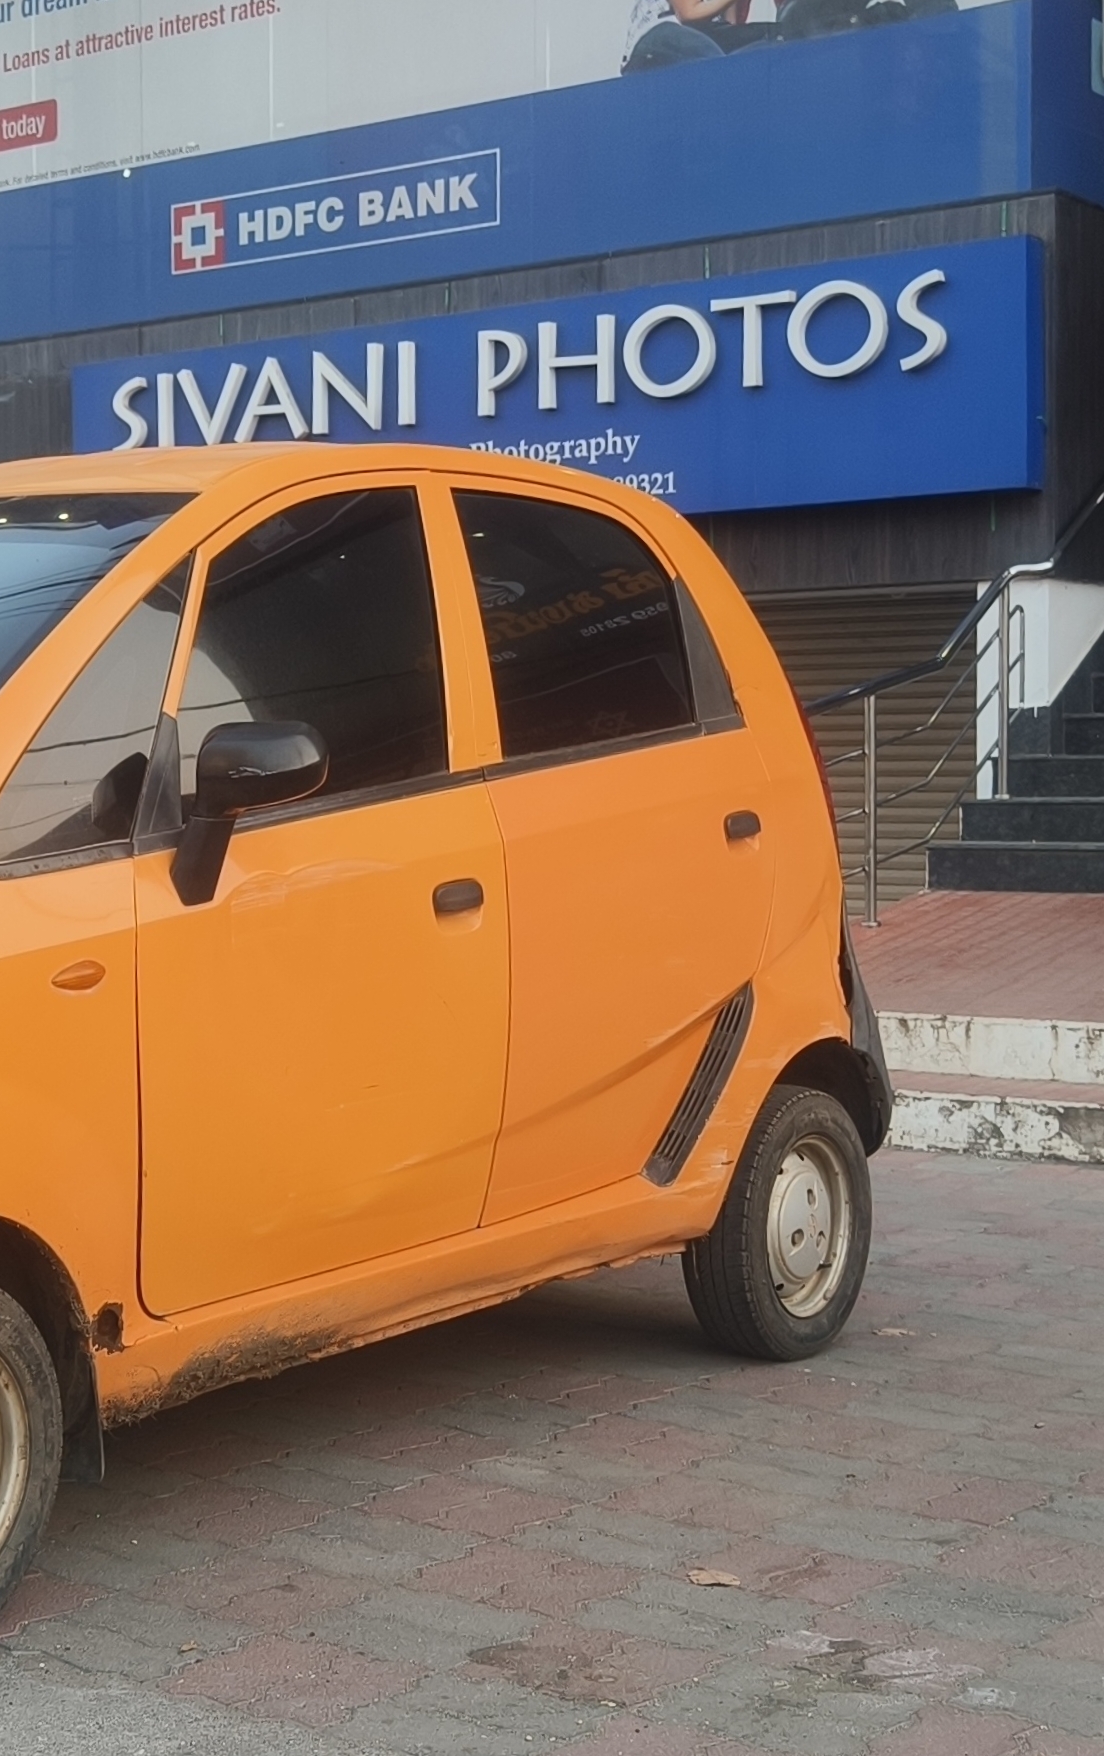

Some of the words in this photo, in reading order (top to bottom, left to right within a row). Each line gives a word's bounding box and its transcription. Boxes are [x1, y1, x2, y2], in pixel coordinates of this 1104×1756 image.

[3, 47, 50, 74] Loans
[55, 39, 71, 62] at
[75, 22, 154, 58] attractive
[159, 4, 226, 38] interest
[2, 113, 46, 140] today
[239, 197, 344, 245] HDFC
[358, 173, 479, 228] BANK
[112, 341, 416, 452] SIVANI
[477, 269, 948, 418] PHOTOS
[613, 471, 677, 495] 9321
